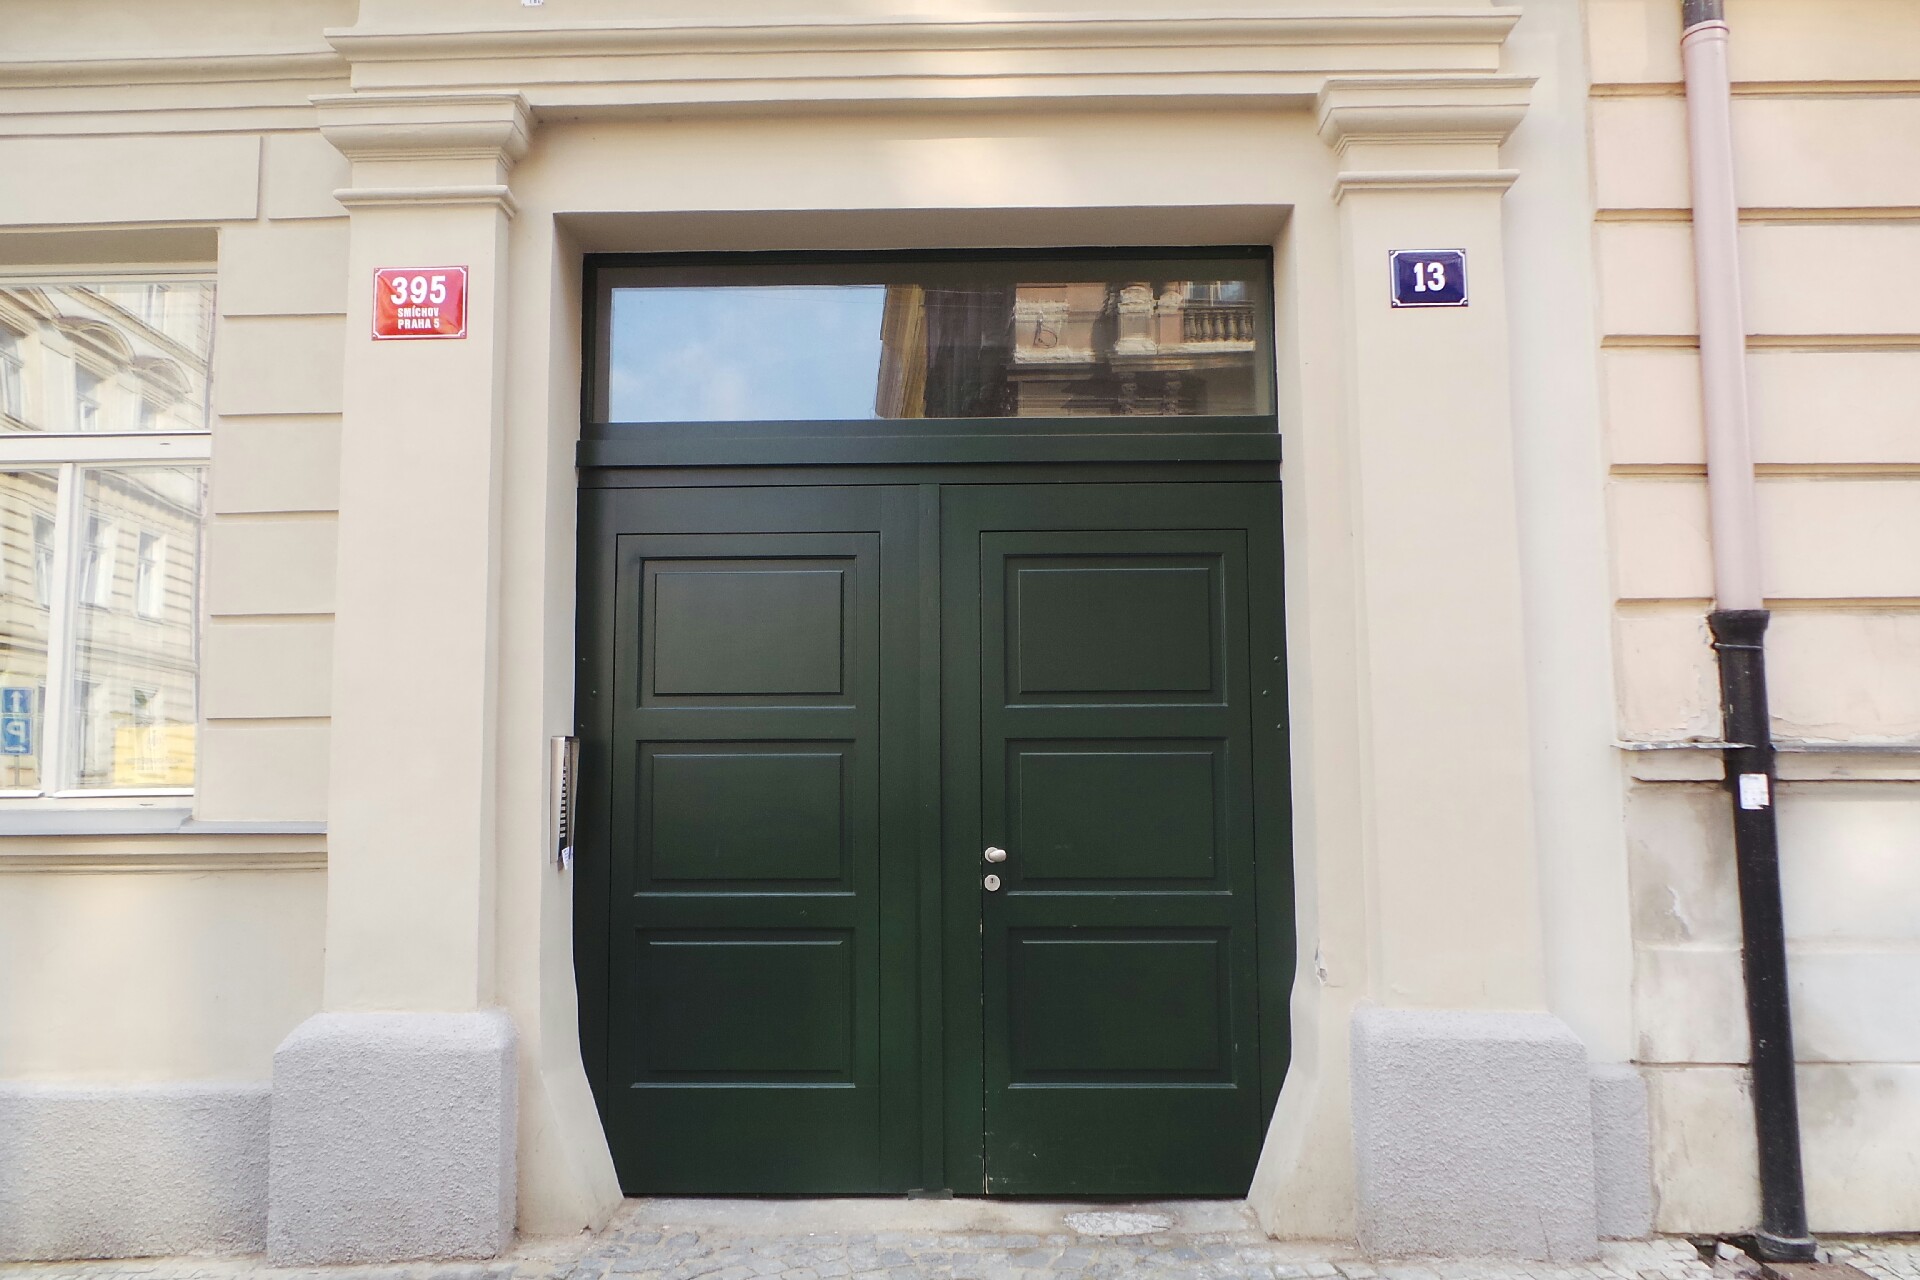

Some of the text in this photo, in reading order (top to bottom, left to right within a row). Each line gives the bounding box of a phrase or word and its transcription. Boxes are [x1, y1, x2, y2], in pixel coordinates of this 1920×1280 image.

[1413, 262, 1446, 292] 13
[390, 275, 447, 305] 395
[397, 304, 439, 318] SMÍCHOV
[397, 317, 440, 330] PRAHA 5
